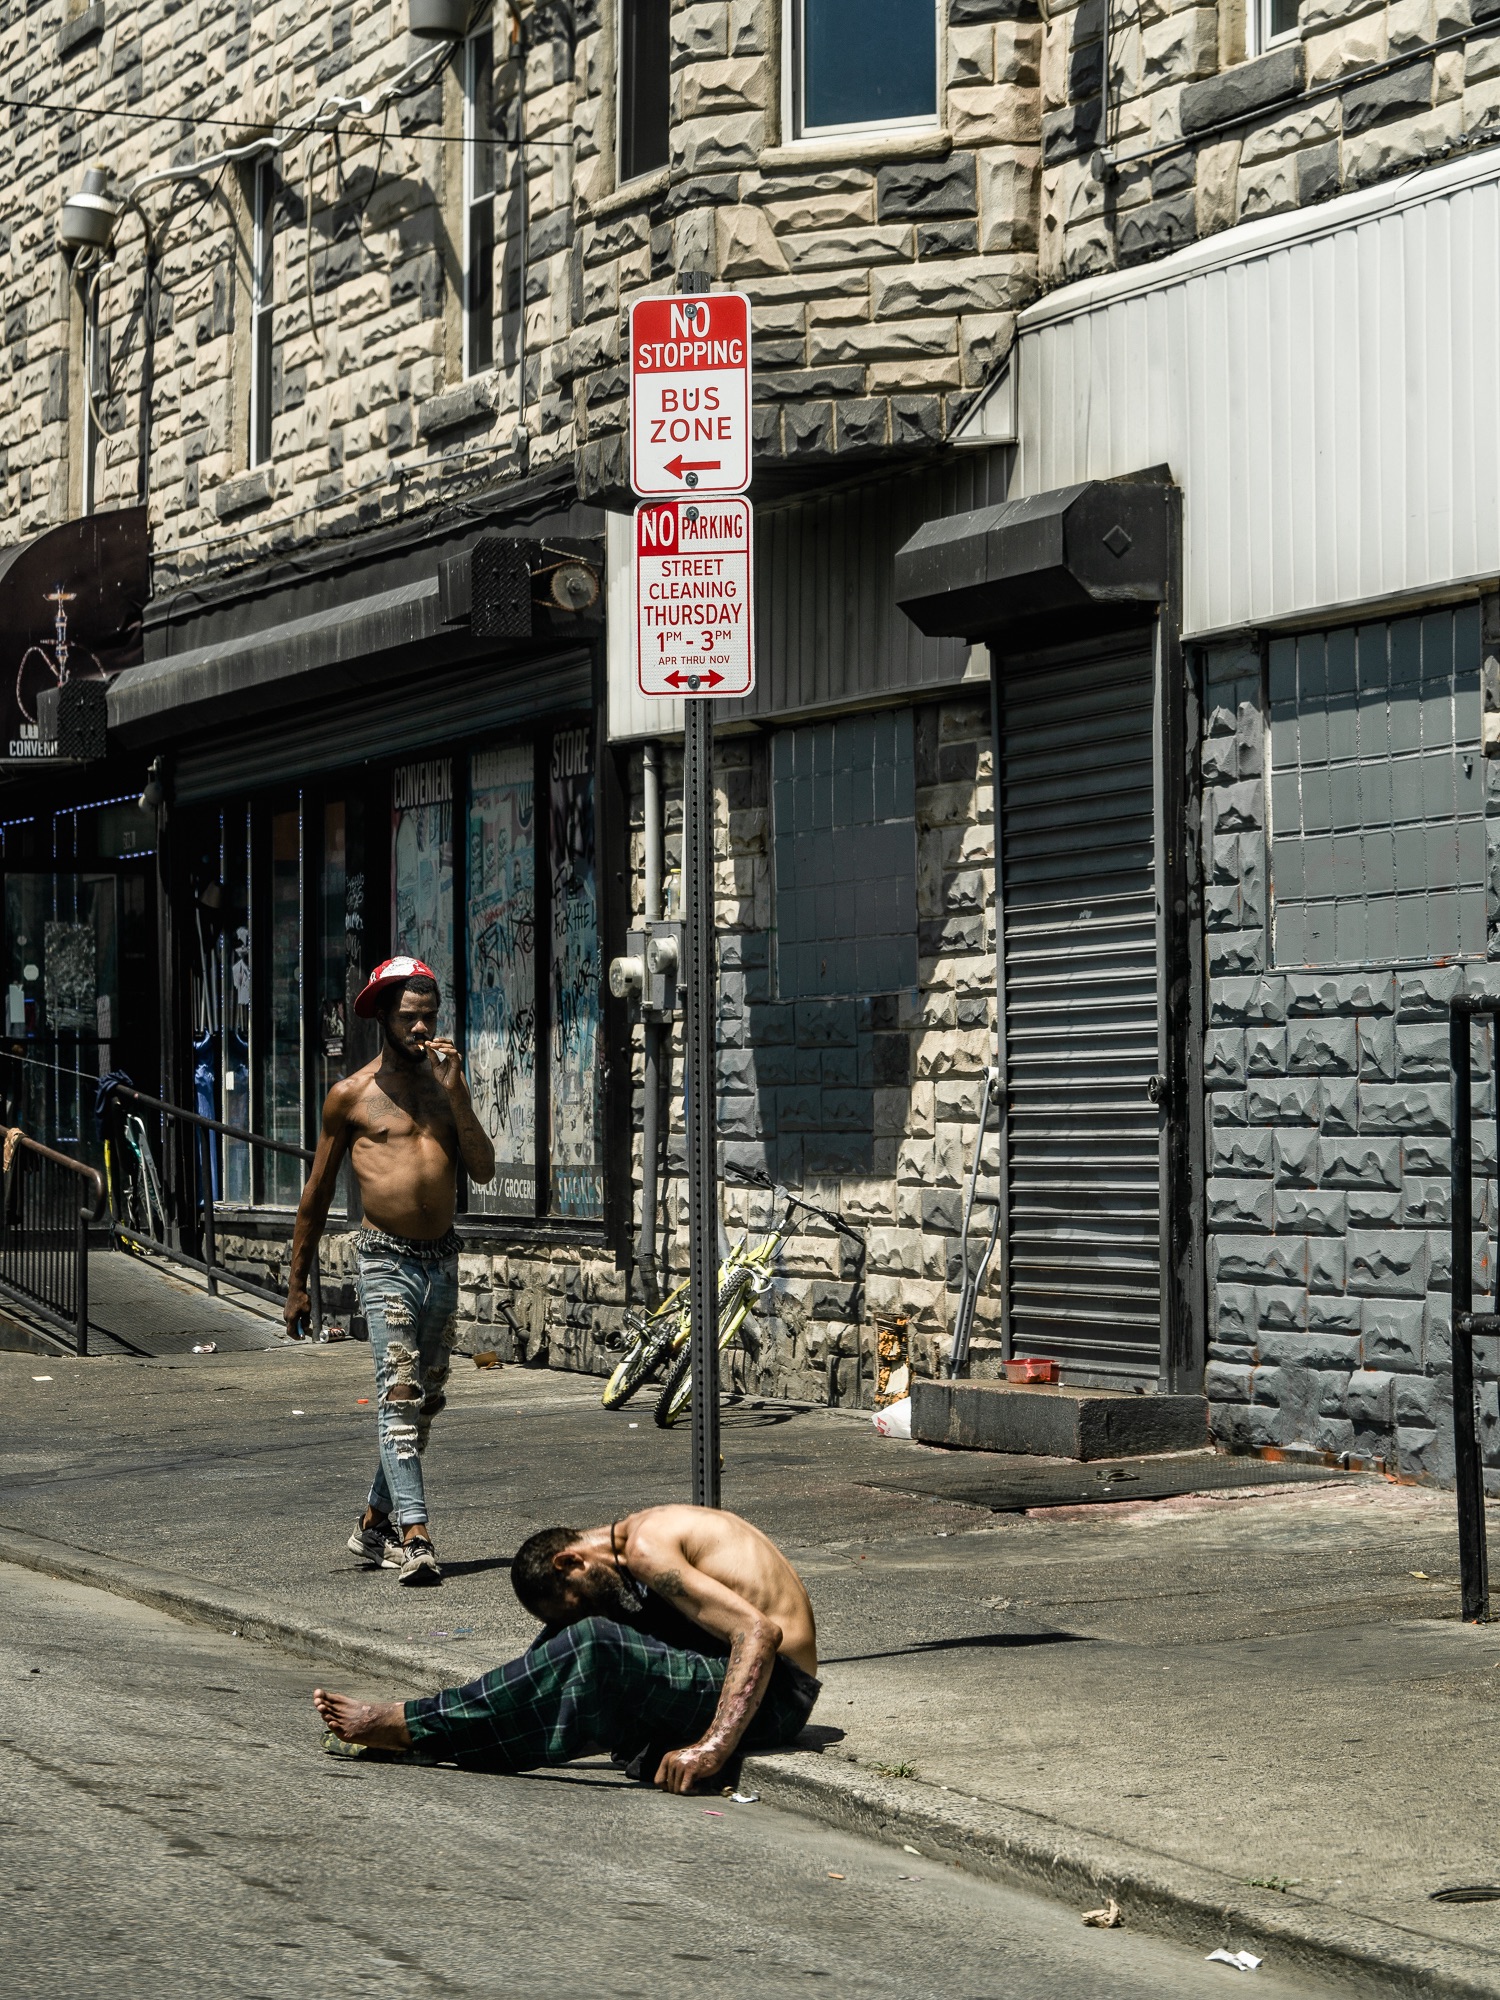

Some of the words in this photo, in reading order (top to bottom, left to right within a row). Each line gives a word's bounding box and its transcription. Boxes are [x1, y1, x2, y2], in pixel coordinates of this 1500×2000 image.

[670, 301, 710, 339] NO
[638, 338, 743, 369] STOPPING
[661, 386, 720, 413] BUS
[650, 416, 732, 443] ZONE
[641, 509, 675, 547] NO
[681, 514, 743, 540] PARKING
[661, 558, 724, 577] STREET
[649, 580, 737, 600] CLEANING
[643, 602, 743, 626] THURSDAY
[656, 631, 682, 653] 1PM
[700, 630, 732, 652] 3PM
[658, 655, 677, 665] APR
[681, 655, 706, 665] THRU
[709, 654, 730, 664] NOV
[552, 727, 590, 779] STORE
[558, 1176, 594, 1204] SMOKE
